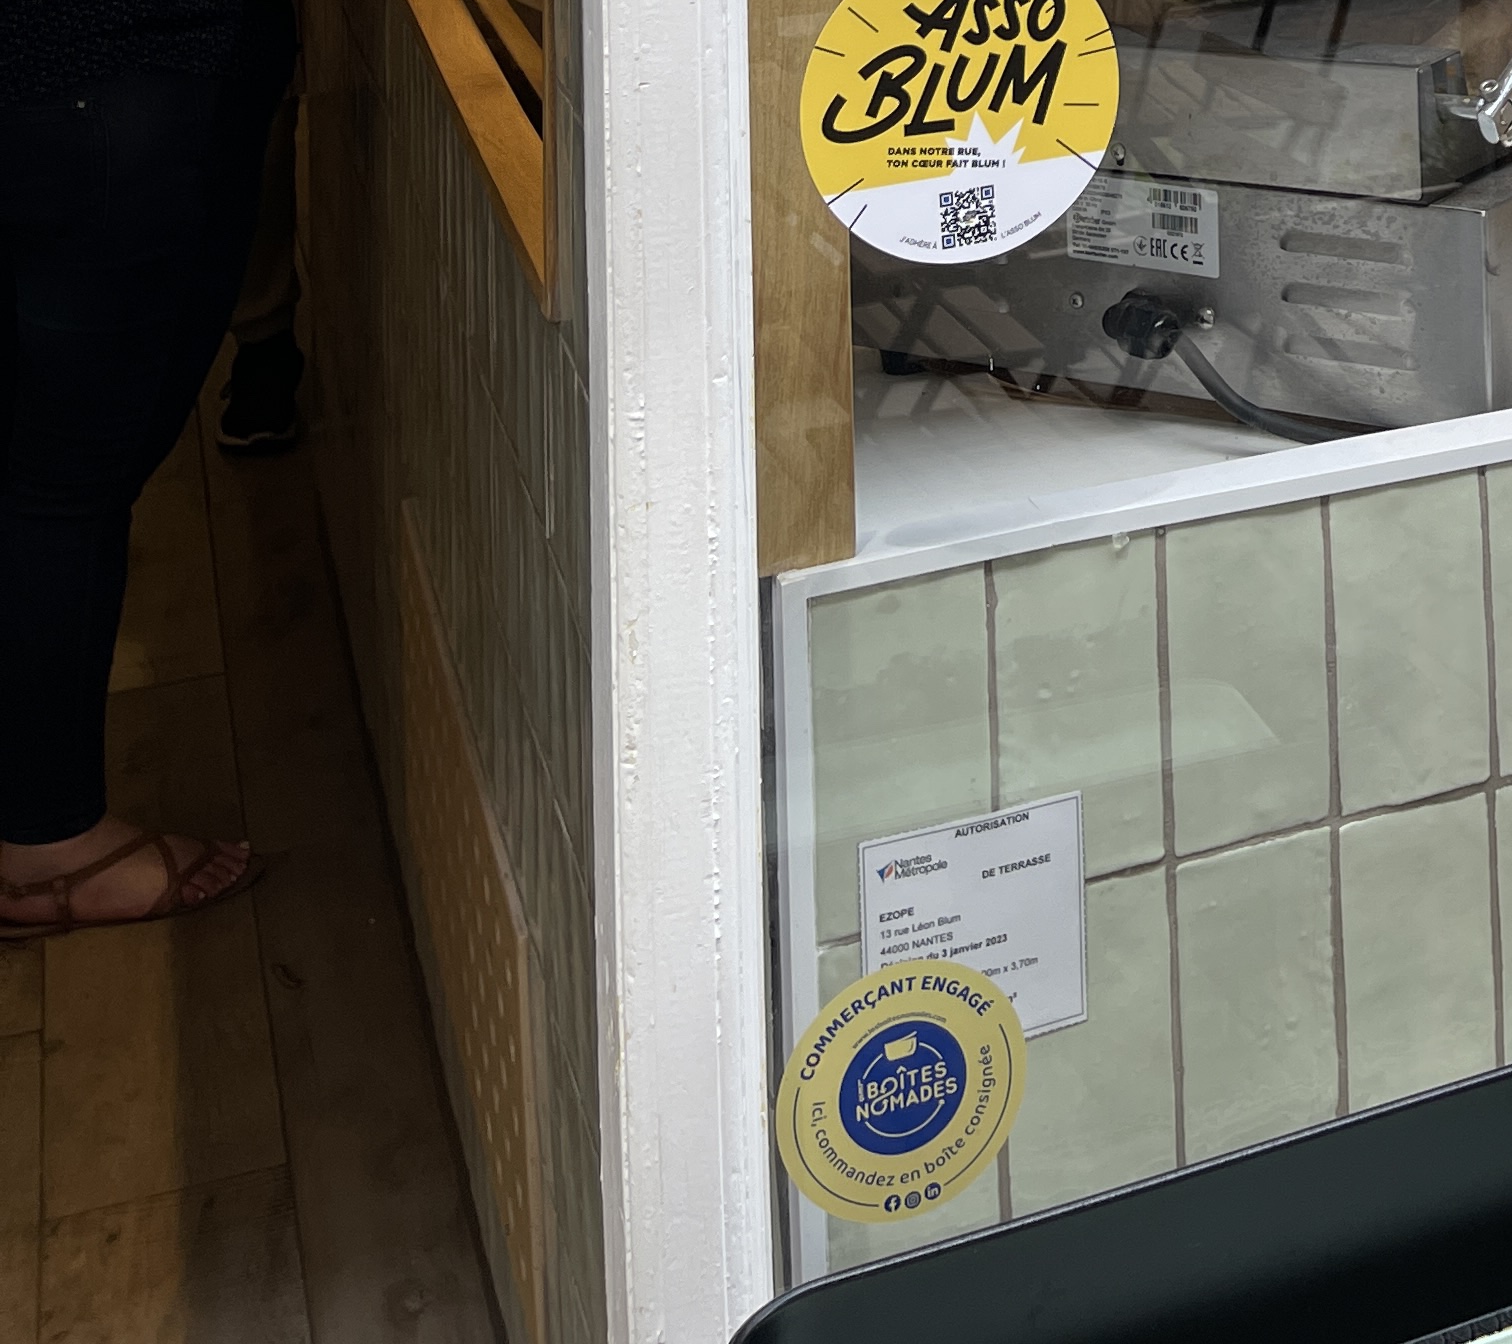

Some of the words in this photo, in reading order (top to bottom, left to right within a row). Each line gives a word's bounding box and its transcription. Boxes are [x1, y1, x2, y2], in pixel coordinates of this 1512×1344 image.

[822, 40, 1067, 144] BLUM
[887, 147, 917, 156] DANS
[919, 147, 955, 156] NOTRE
[957, 147, 982, 158] RUE,
[887, 159, 909, 168] TON
[911, 159, 943, 169] CŒUR
[945, 159, 970, 169] FAIT
[971, 159, 1000, 168] BLUM
[1023, 211, 1042, 227] BLUM
[954, 812, 1030, 838] AUTORISATION
[893, 853, 932, 869] Nantes
[893, 859, 948, 880] Métropole
[981, 867, 996, 879] DE
[998, 853, 1051, 875] TERRASSE
[879, 907, 915, 923] EZOPE
[880, 929, 892, 940] 13
[894, 928, 910, 938] rue
[911, 920, 935, 934] Léon
[937, 914, 961, 927] Blum
[879, 942, 910, 956] 44000
[911, 931, 954, 949] NANTES
[941, 949, 948, 959] 3
[949, 941, 983, 959] janvier
[985, 933, 1008, 948] 2023
[1010, 956, 1039, 972] 3,70m
[800, 976, 917, 1081] COMMERÇANT
[920, 975, 996, 1017] ENGAGÉ
[866, 1061, 948, 1100] BOÎTES
[964, 1043, 997, 1136] consignée
[855, 1077, 959, 1122] NOMADES
[811, 1100, 826, 1128] Ici,
[814, 1129, 896, 1188] commandez
[923, 1137, 967, 1175] boîte
[899, 1169, 921, 1185] en
